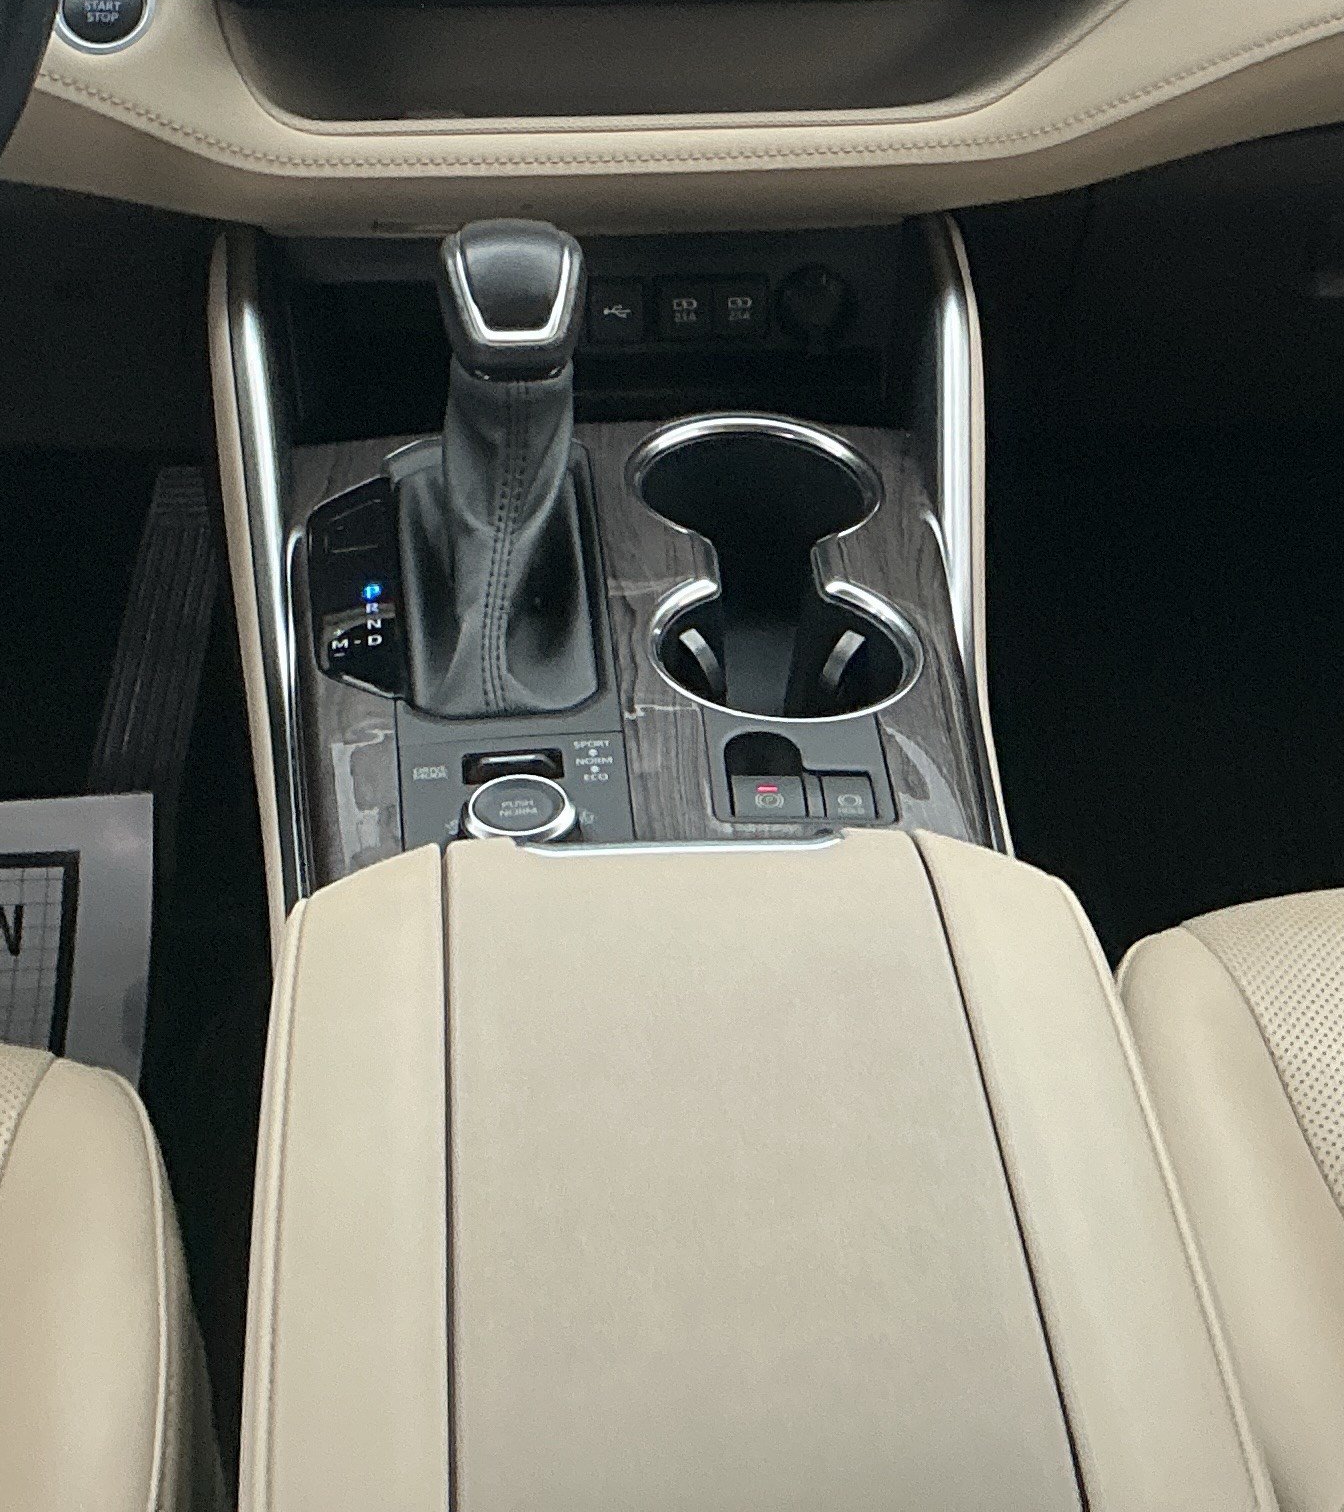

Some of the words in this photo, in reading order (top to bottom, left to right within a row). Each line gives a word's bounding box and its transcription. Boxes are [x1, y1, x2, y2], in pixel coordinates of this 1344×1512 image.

[84, 0, 121, 11] START
[86, 12, 119, 23] STOP
[365, 584, 380, 599] P
[365, 603, 379, 614] R
[367, 618, 382, 630] N
[331, 638, 349, 650] M
[367, 634, 383, 646] D
[573, 740, 610, 750] SPORT
[575, 757, 613, 766] NORM
[583, 773, 609, 782] ECO
[501, 799, 534, 808] PUSH
